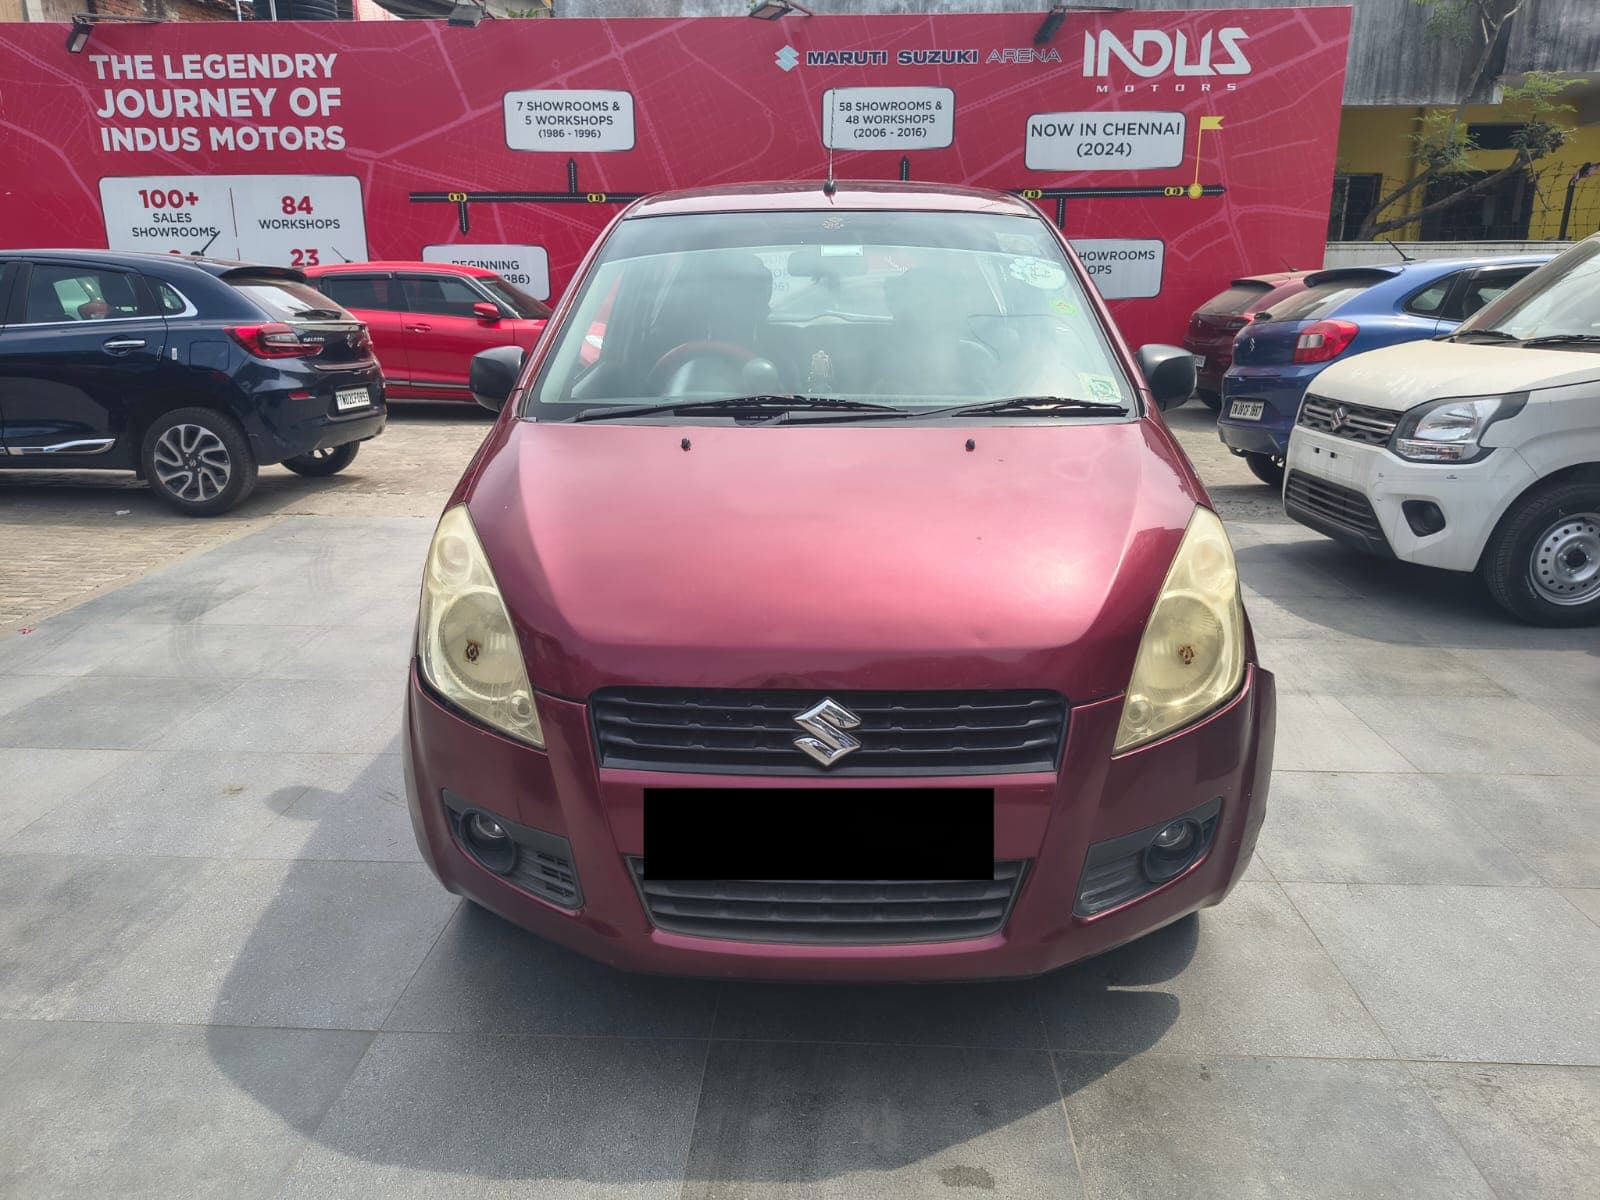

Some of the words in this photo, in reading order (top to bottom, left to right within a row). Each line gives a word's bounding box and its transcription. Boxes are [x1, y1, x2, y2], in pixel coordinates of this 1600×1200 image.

[807, 50, 888, 66] MARUTI
[897, 49, 979, 65] SUZUKI
[986, 48, 1062, 63] ARENA
[1083, 27, 1252, 78] INDUS
[89, 54, 156, 80] THE
[163, 53, 338, 80] LEGENDRY
[1096, 83, 1237, 93] MOTORS
[97, 87, 277, 118] JOURNEY
[289, 87, 342, 117] OF
[517, 102, 523, 111] 7
[527, 101, 609, 112] SHOWROOMS
[612, 102, 620, 111] &
[839, 102, 853, 112] 58
[856, 101, 932, 112] SHOWROOMS
[935, 101, 942, 111] &
[525, 116, 532, 125] 5
[535, 115, 614, 126] WORKSHOPS
[845, 115, 860, 125] 48
[863, 114, 935, 125] WORKSHOPS
[538, 129, 565, 139] (1986
[574, 129, 602, 139] 1996)
[853, 128, 887, 139] (2006
[897, 127, 927, 138] 2016)
[1031, 123, 1075, 137] NOW
[1080, 123, 1097, 136] IN
[1103, 122, 1181, 136] CHENNAI
[101, 127, 201, 152] INDUS
[209, 125, 346, 151] MOTORS
[1076, 142, 1133, 158] (2024)
[138, 189, 199, 209] 100+
[281, 196, 313, 215] 84
[152, 212, 192, 223] SALES
[259, 218, 341, 230] WORKSHOPS
[132, 226, 217, 237] SHOWROOMS
[290, 249, 320, 267] 23
[1078, 250, 1157, 261] HOWROOMS
